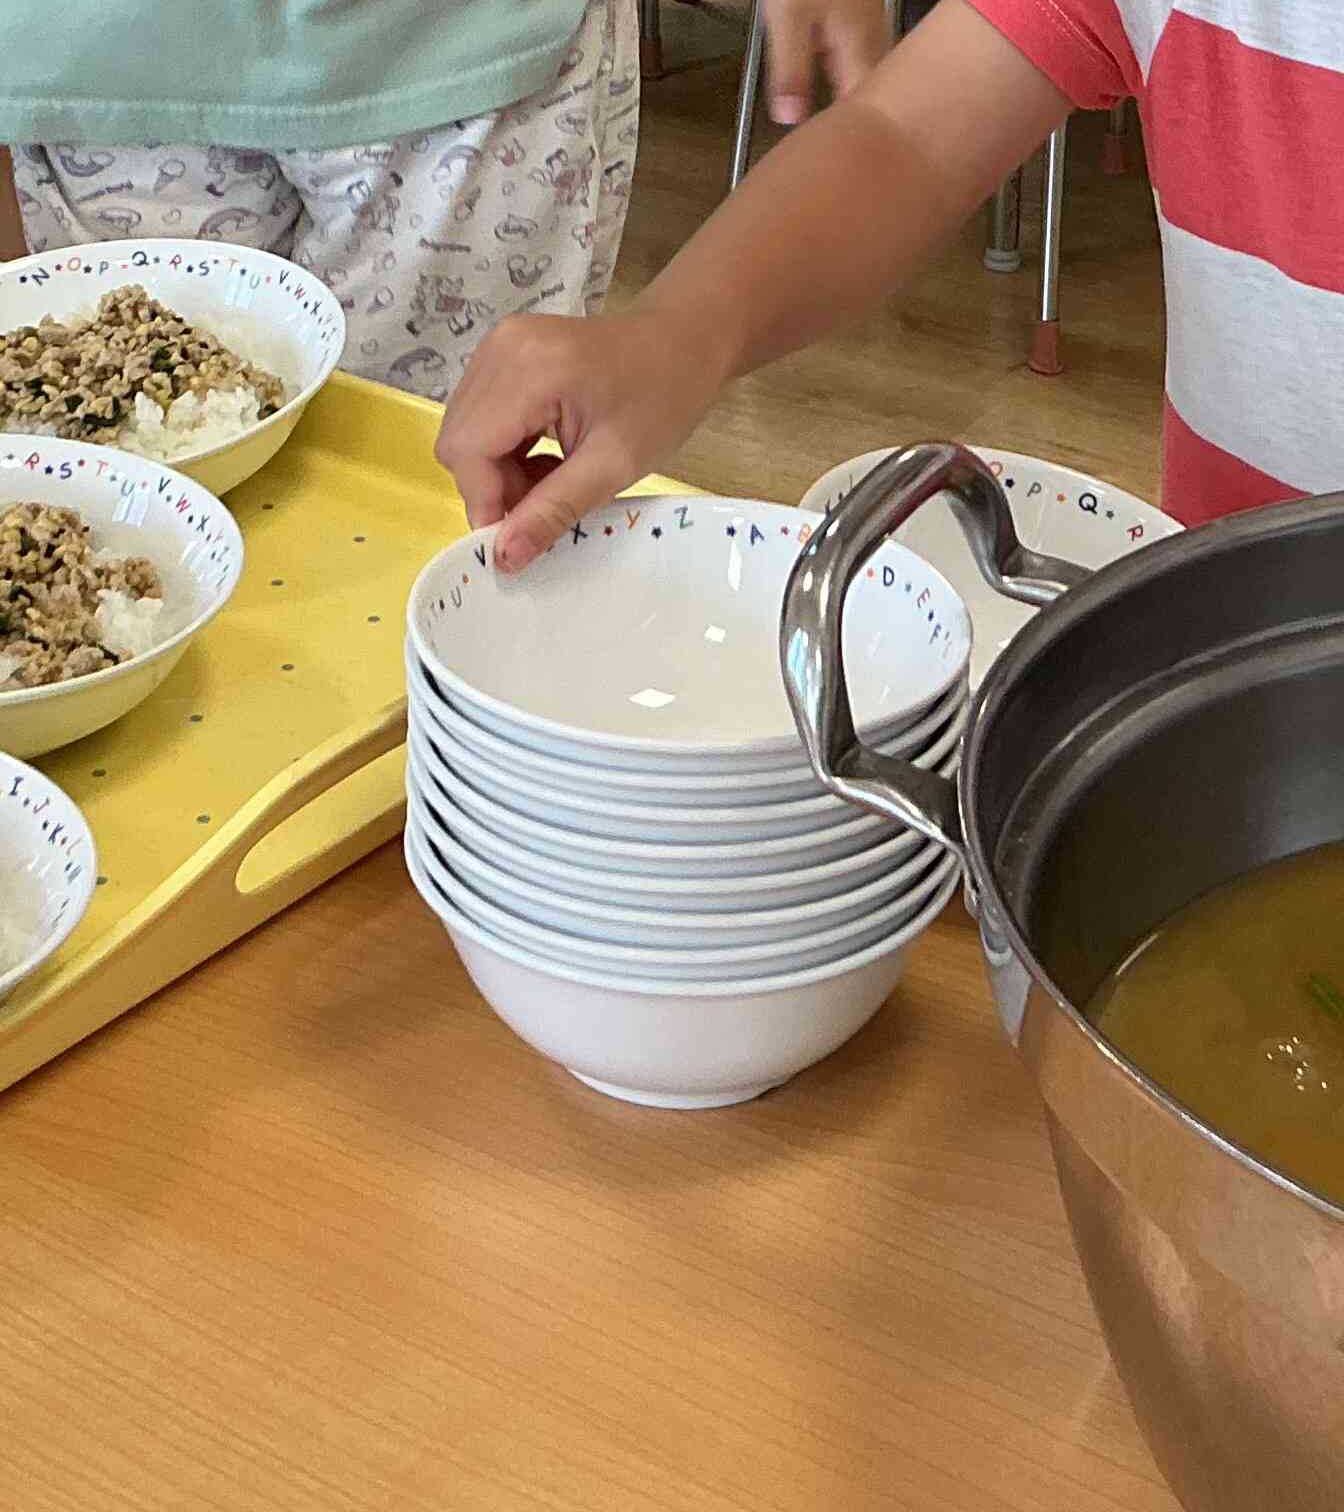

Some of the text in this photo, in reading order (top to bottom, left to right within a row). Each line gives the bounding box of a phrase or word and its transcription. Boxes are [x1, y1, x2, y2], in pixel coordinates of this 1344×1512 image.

[31, 268, 50, 286] N
[67, 257, 81, 271] O
[99, 261, 109, 275] P
[132, 251, 149, 266] Q
[169, 255, 182, 269] R
[199, 261, 209, 276] S
[249, 274, 261, 290] U
[280, 270, 289, 284] V
[294, 283, 305, 300] W
[25, 452, 40, 470] R
[60, 462, 72, 479] S
[96, 460, 109, 476] T
[121, 480, 135, 497] U
[158, 477, 171, 493] V
[176, 494, 191, 512] W
[196, 515, 209, 532] X
[1027, 482, 1041, 497] P
[1079, 493, 1097, 514] Q
[451, 586, 462, 608] U
[475, 544, 485, 567] V
[571, 523, 588, 544] X
[627, 511, 640, 529] Y
[675, 506, 693, 529] Z
[750, 525, 764, 545] A
[883, 566, 894, 586] D
[9, 777, 23, 796] I
[33, 797, 50, 814] J
[48, 824, 64, 844] K
